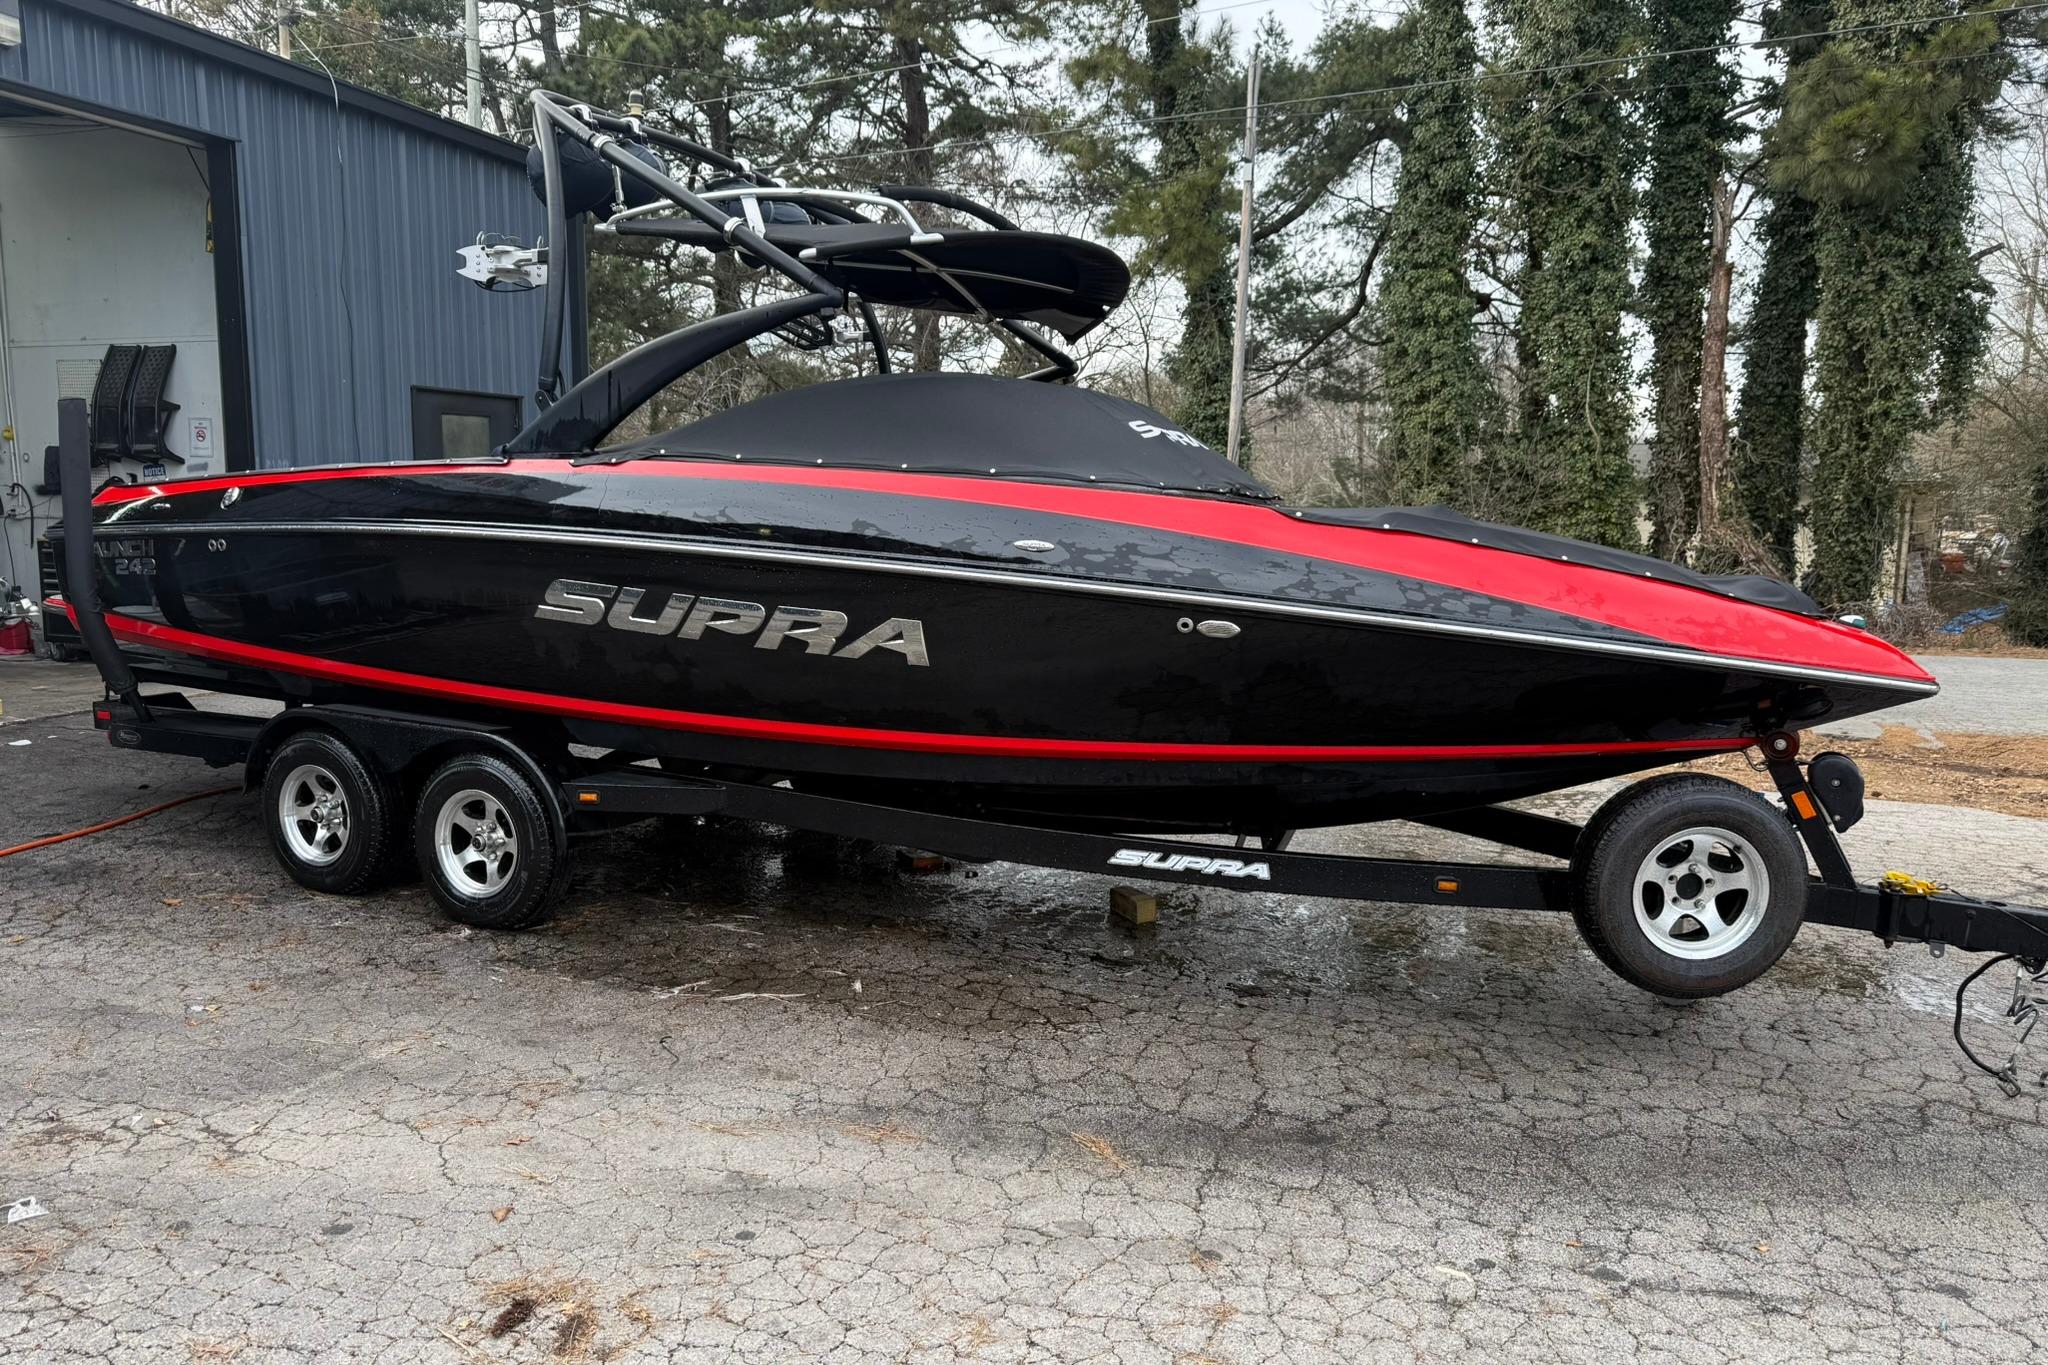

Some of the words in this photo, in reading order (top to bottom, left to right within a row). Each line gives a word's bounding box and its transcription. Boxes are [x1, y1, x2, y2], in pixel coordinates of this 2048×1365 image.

[144, 466, 165, 476] NOTICE
[93, 540, 154, 557] AUNCH
[534, 578, 930, 667] SUPRA
[1106, 848, 1271, 880] SUPRA
